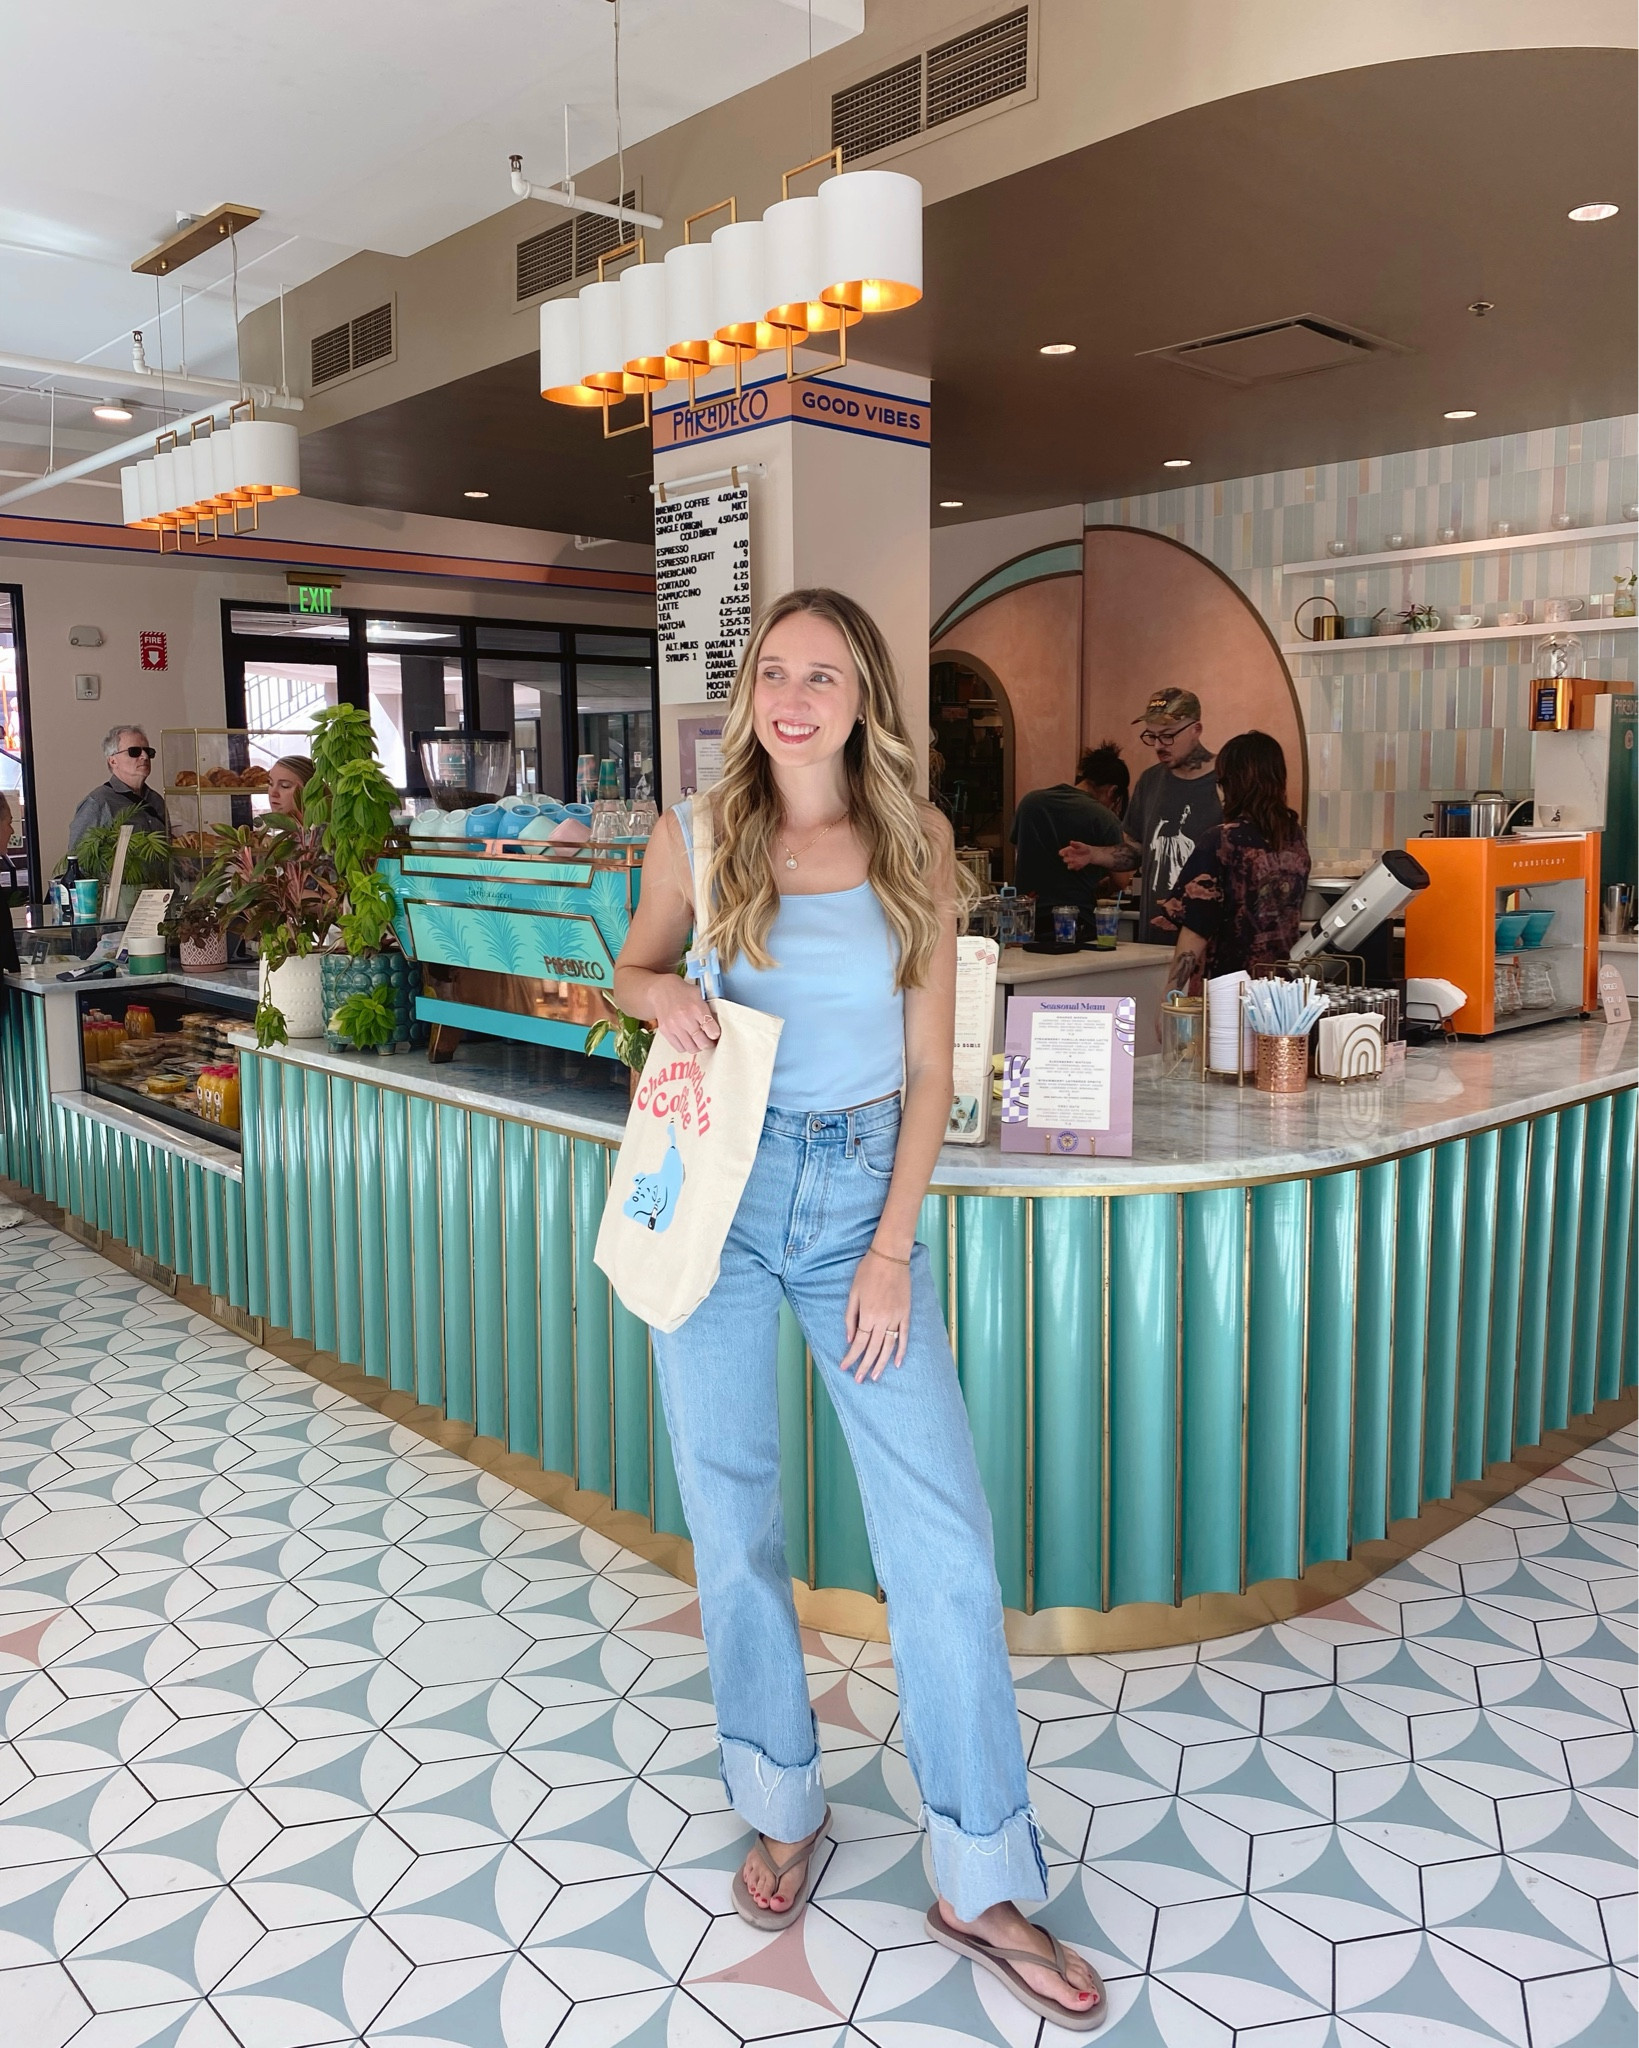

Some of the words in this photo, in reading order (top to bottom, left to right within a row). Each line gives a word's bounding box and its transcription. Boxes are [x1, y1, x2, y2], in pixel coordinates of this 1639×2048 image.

[802, 391, 860, 417] GOOD
[865, 404, 921, 430] VIBES
[656, 503, 682, 515] BREWED
[684, 497, 710, 509] COFFEE
[656, 515, 673, 525] POUR
[675, 511, 693, 521] OVER
[731, 501, 747, 511] MKT
[656, 524, 679, 535] SINGLE
[680, 520, 703, 531] ORIGIN
[718, 512, 748, 524] 4.50/5.00
[680, 531, 698, 541] COLD
[699, 527, 718, 538] BREW
[656, 544, 689, 556] ESPRESSO
[733, 540, 748, 549] 4.00
[657, 556, 689, 568] ESPRESSO
[691, 551, 715, 563] FLIGHT
[657, 566, 697, 580] AMERICANO
[733, 560, 748, 569] 4.00
[657, 579, 690, 591] CORTADO
[733, 571, 749, 580] 4.25
[299, 586, 333, 614] EXIT
[657, 588, 701, 602] CAPPUCCINO
[734, 582, 749, 592] 4.50
[658, 601, 679, 611] LATTE
[720, 594, 750, 604] 4.75/5.25
[658, 612, 671, 622] TEA
[658, 620, 686, 631] MATCHA
[720, 617, 750, 627] 5.25/5.75
[144, 636, 162, 644] FIRE
[658, 632, 675, 641] CHAI
[720, 628, 750, 637] 4.25/4.75
[739, 639, 744, 647] 1
[665, 653, 689, 662] SYRUPS
[706, 650, 733, 659] VANILLA
[705, 659, 738, 669] CARAMEL
[706, 681, 731, 690] MOCHA
[706, 690, 728, 700] LOCAL
[543, 955, 605, 981] PARADECO
[1040, 1002, 1079, 1010] Seasonal
[1081, 1003, 1106, 1011] Menu
[637, 1054, 712, 1137] Chamberlain
[652, 1086, 691, 1130] Coffee
